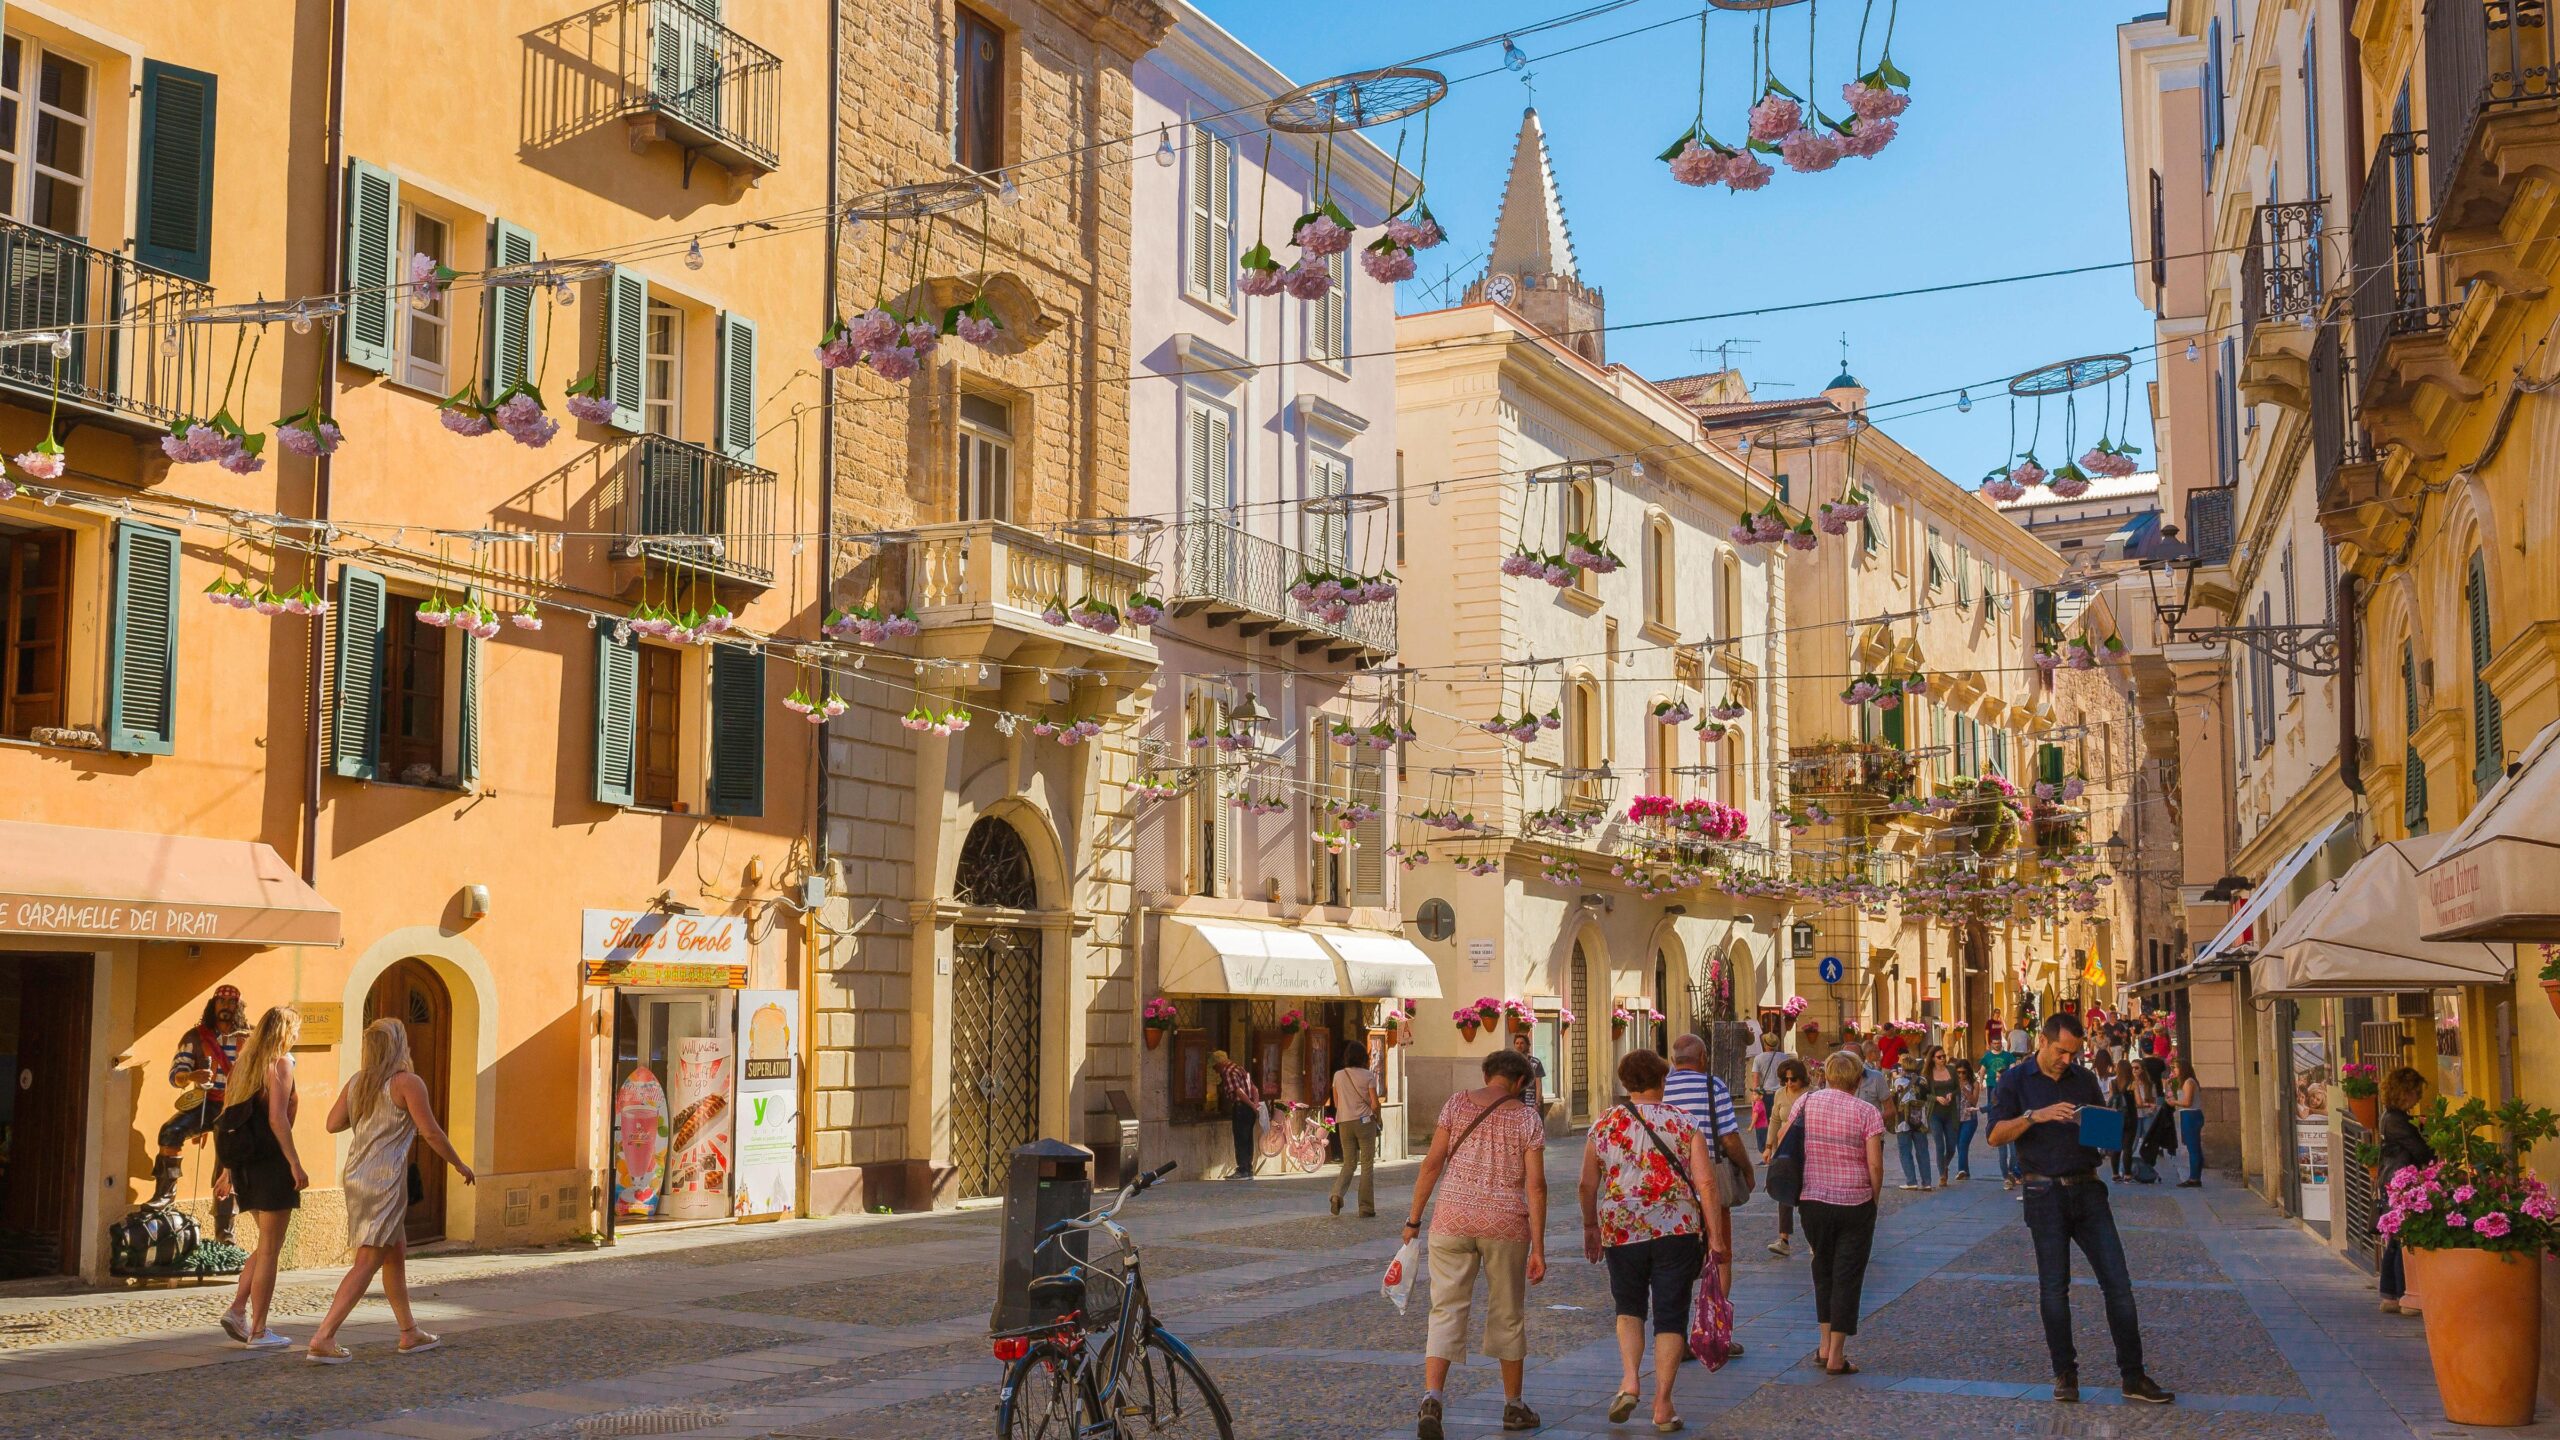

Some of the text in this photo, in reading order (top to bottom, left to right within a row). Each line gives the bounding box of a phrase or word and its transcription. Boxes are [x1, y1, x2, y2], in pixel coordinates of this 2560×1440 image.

[17, 902, 120, 930] CARAMELLE
[130, 908, 156, 931] DEI
[166, 909, 218, 935] PIRATI
[603, 916, 732, 960] King's Creole
[1794, 927, 1811, 948] T
[748, 1061, 789, 1077] SUPERLATIVO
